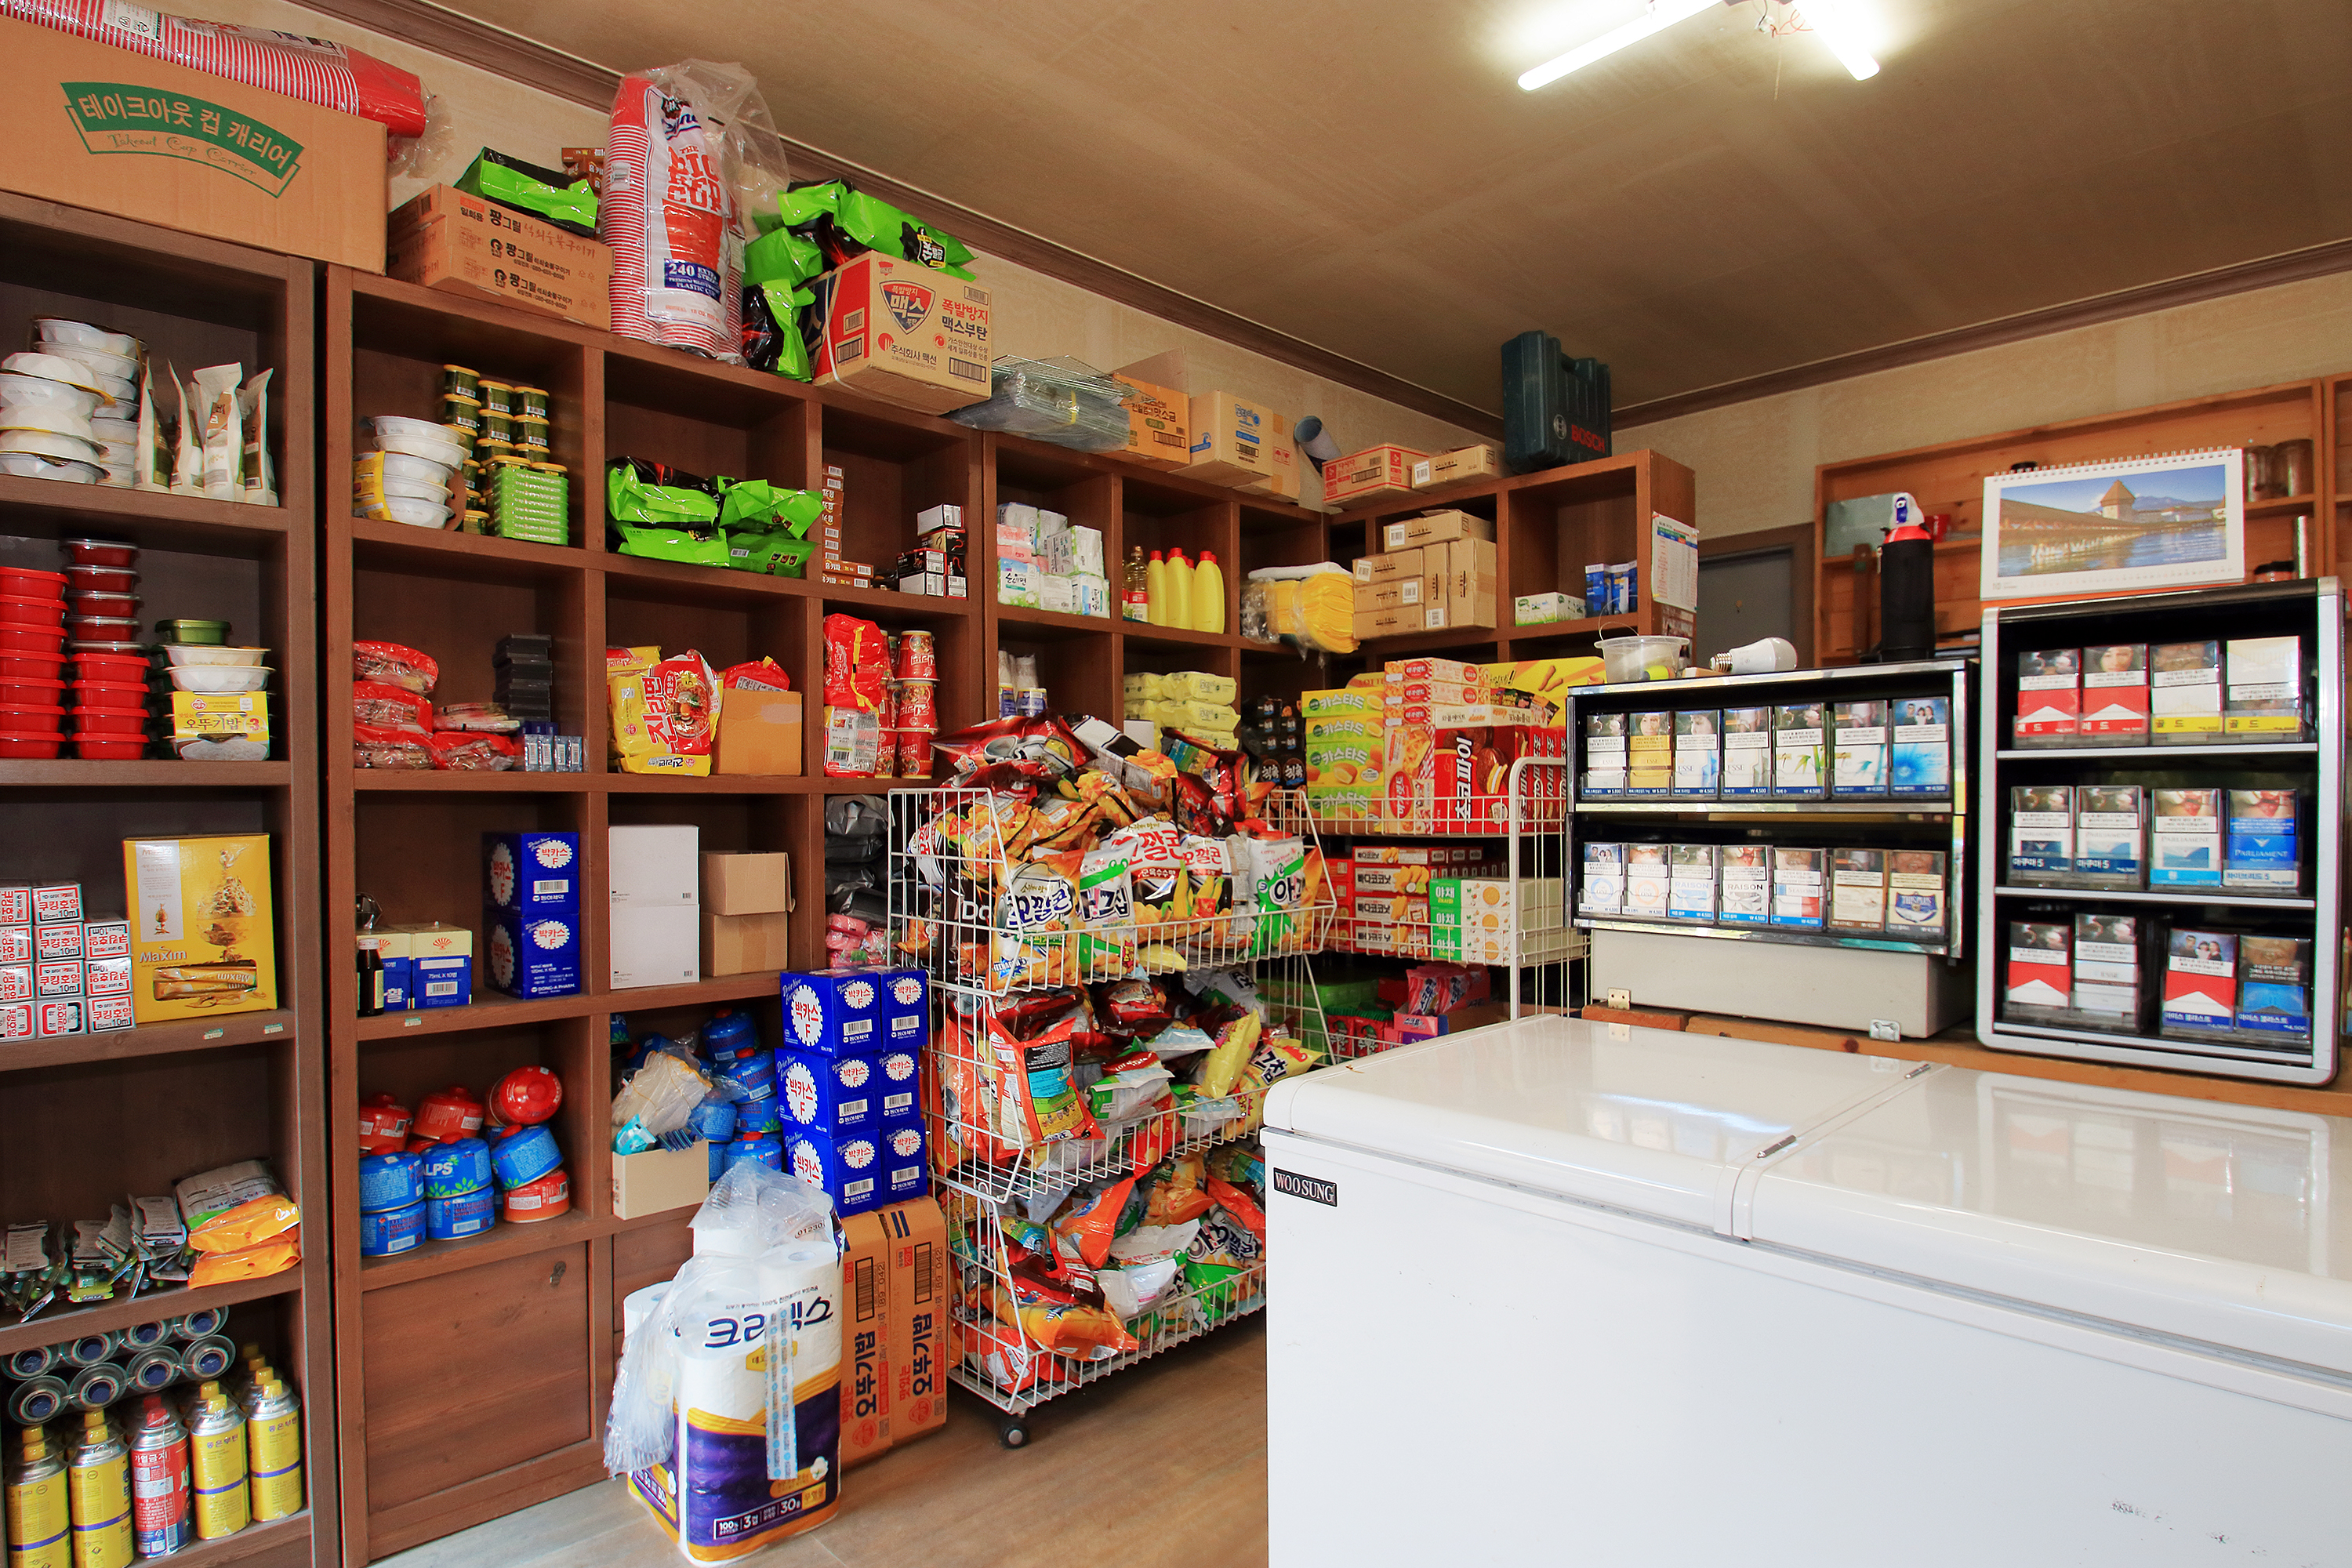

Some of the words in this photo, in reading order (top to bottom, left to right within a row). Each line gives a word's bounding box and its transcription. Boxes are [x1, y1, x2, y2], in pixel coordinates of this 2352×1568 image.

[78, 93, 193, 129] 테이크아웃
[199, 107, 222, 136] 컵
[227, 120, 292, 170] 캐리어
[669, 263, 694, 276] 240
[890, 295, 925, 318] 맥스
[942, 298, 989, 325] 폭발방지
[942, 316, 988, 342] 맥스부탄
[891, 344, 920, 361] 주식회사
[1570, 423, 1606, 452] BOSCH
[1319, 694, 1365, 710] 카스타드
[642, 677, 678, 745] 진라면
[183, 717, 241, 731] 오뚜기밥
[249, 718, 260, 731] 3
[1323, 720, 1364, 736] 카스타드
[1321, 747, 1367, 764] 카스타드
[1455, 737, 1472, 822] 초코파이
[542, 848, 568, 858] 박카스
[1436, 886, 1455, 898] 야채
[39, 899, 79, 911] 쿠킹호일
[1436, 913, 1455, 924] 야채
[539, 928, 565, 938] 박카스
[40, 937, 80, 949] 쿠킹호일
[89, 935, 128, 946] 쿠킹호일
[139, 946, 187, 963] Maxim
[40, 974, 80, 985] 쿠킹호일
[89, 971, 128, 983] 쿠킹호일
[848, 988, 871, 998] 박카스
[897, 985, 920, 995] 박카스
[93, 1007, 132, 1020] 쿠킹호일
[795, 1001, 820, 1022] 박카스
[844, 1067, 866, 1077] 박카스
[888, 1062, 912, 1071] 박카스
[789, 1078, 814, 1101] 박카스
[896, 1137, 919, 1146] 박카스
[848, 1149, 871, 1158] 박카스
[423, 1162, 453, 1176] LPS
[797, 1156, 821, 1179] 박카스
[913, 1312, 932, 1396] 오뚜기밥
[855, 1331, 877, 1417] 오뚜기밥
[134, 1451, 169, 1463] 가열금지
